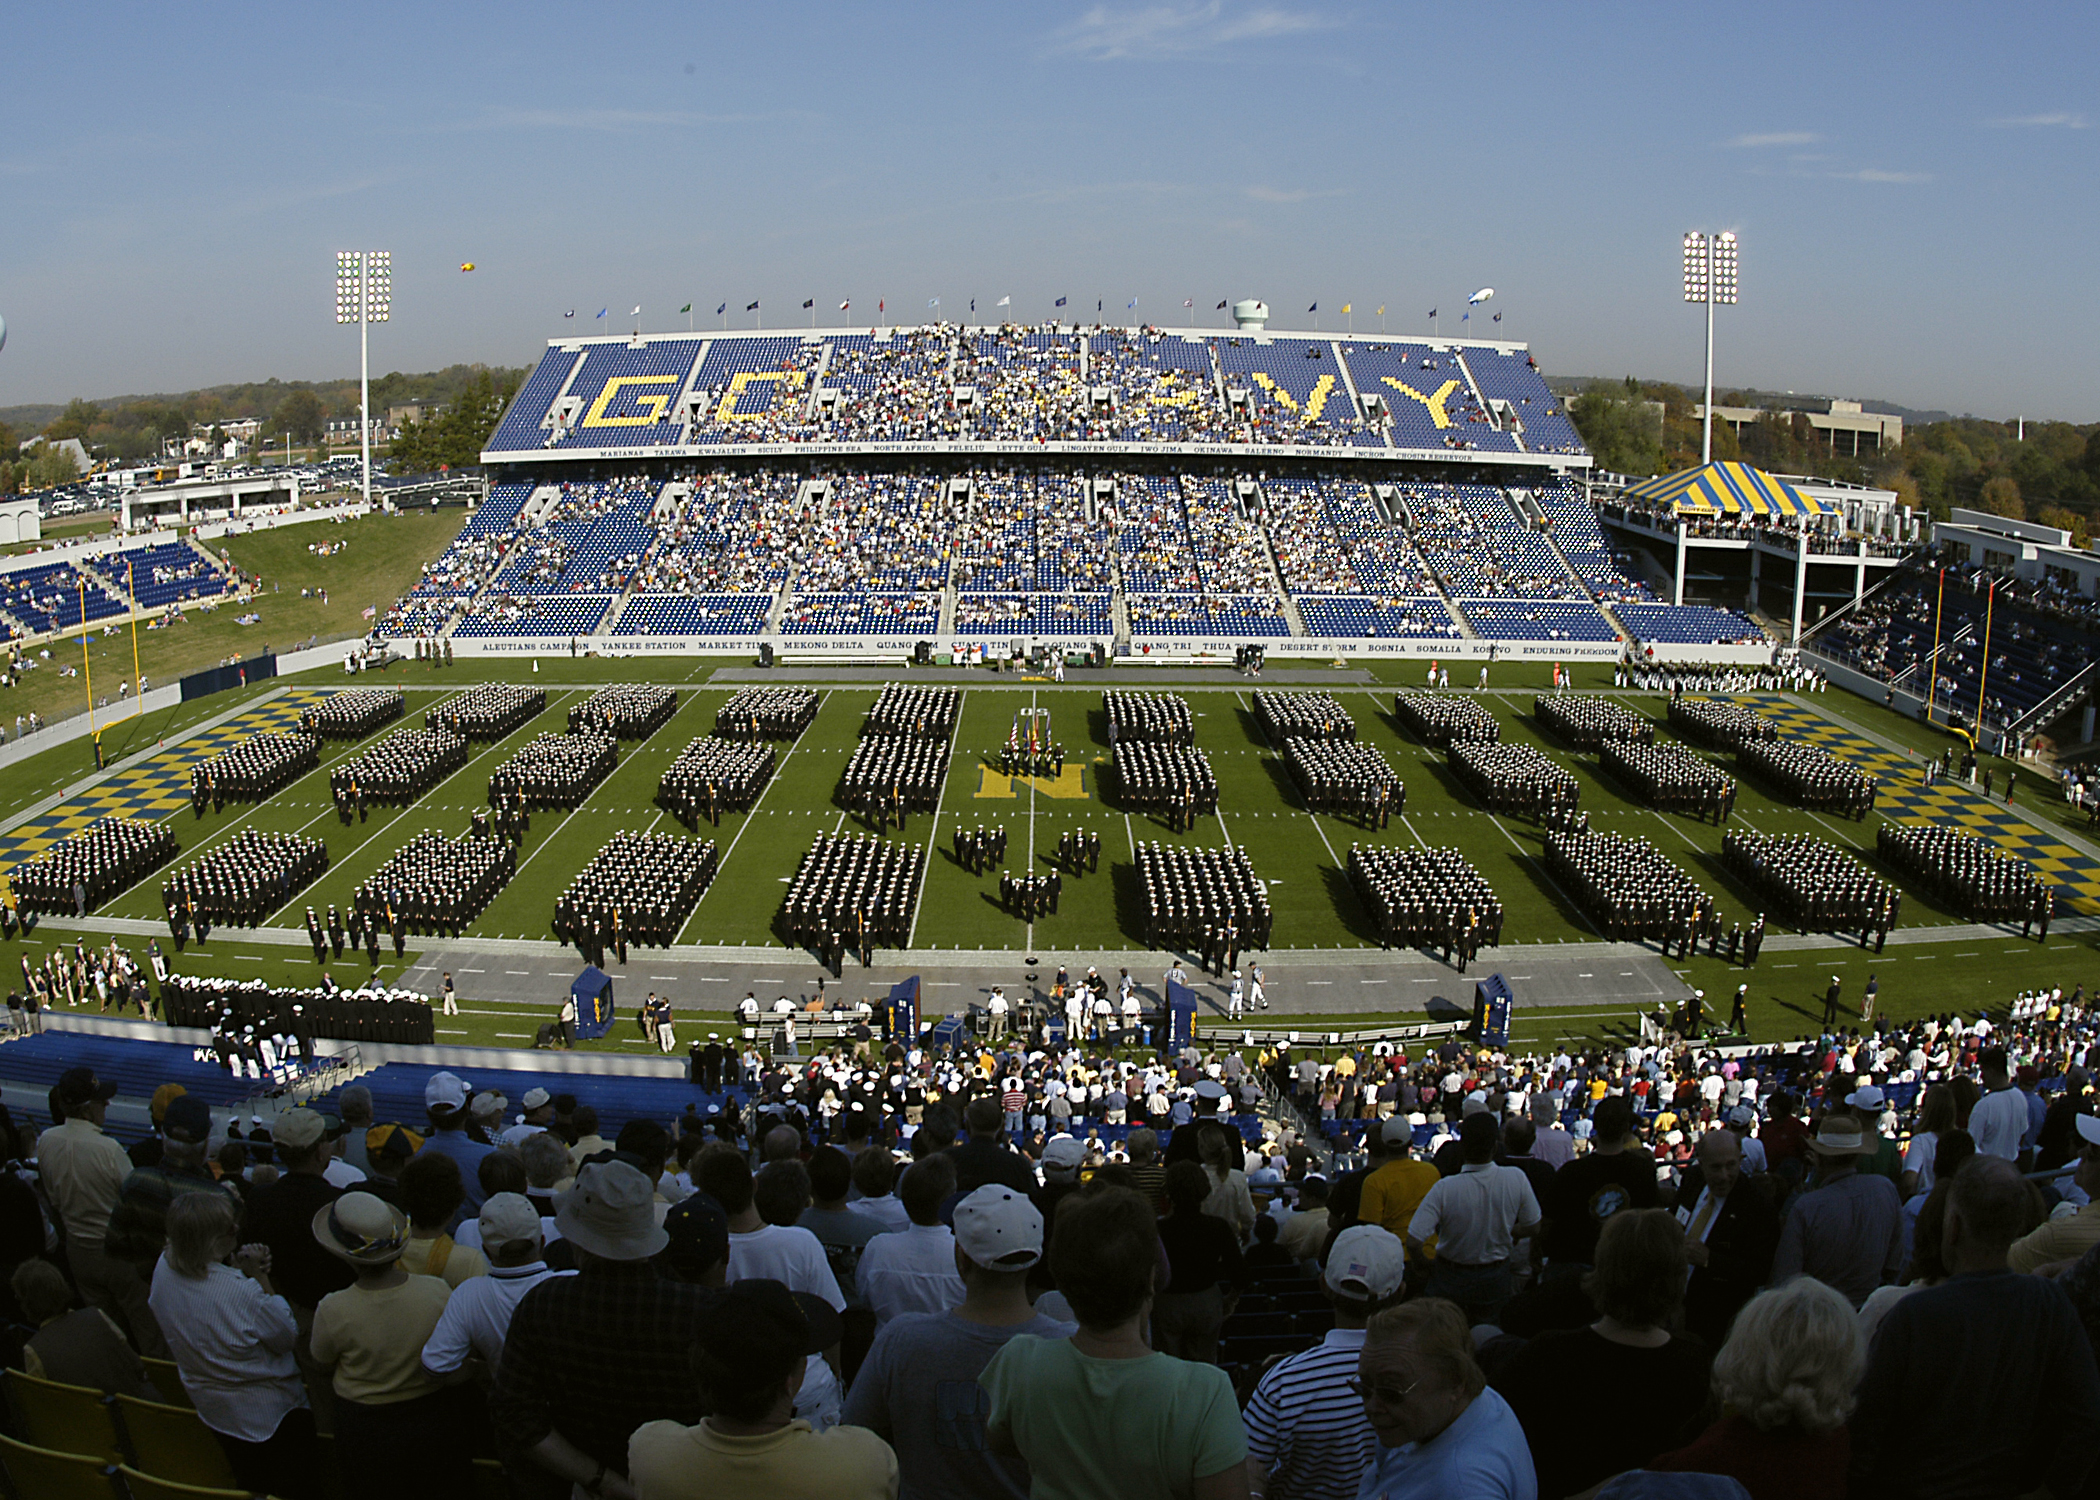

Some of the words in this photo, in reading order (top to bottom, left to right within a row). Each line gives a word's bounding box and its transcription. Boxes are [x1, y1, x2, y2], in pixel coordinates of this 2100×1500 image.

[1295, 449, 1343, 457] NORMANDY
[1428, 454, 1473, 462] RESERVOIR
[482, 643, 536, 651] ALEUTIANS
[601, 642, 642, 650] YANKEE
[698, 641, 743, 649] MARKET
[784, 641, 828, 649] MEKONG
[832, 641, 864, 649] DELTA
[876, 641, 912, 649] QUANG
[990, 641, 1009, 649] TIN
[1172, 642, 1191, 650] TRI
[1279, 643, 1319, 651] DESERT
[1368, 644, 1406, 652] BOSNIA
[1416, 645, 1462, 653] SOMALIA
[1523, 647, 1572, 655] ENDURING
[1574, 648, 1618, 656] FREEDOM
